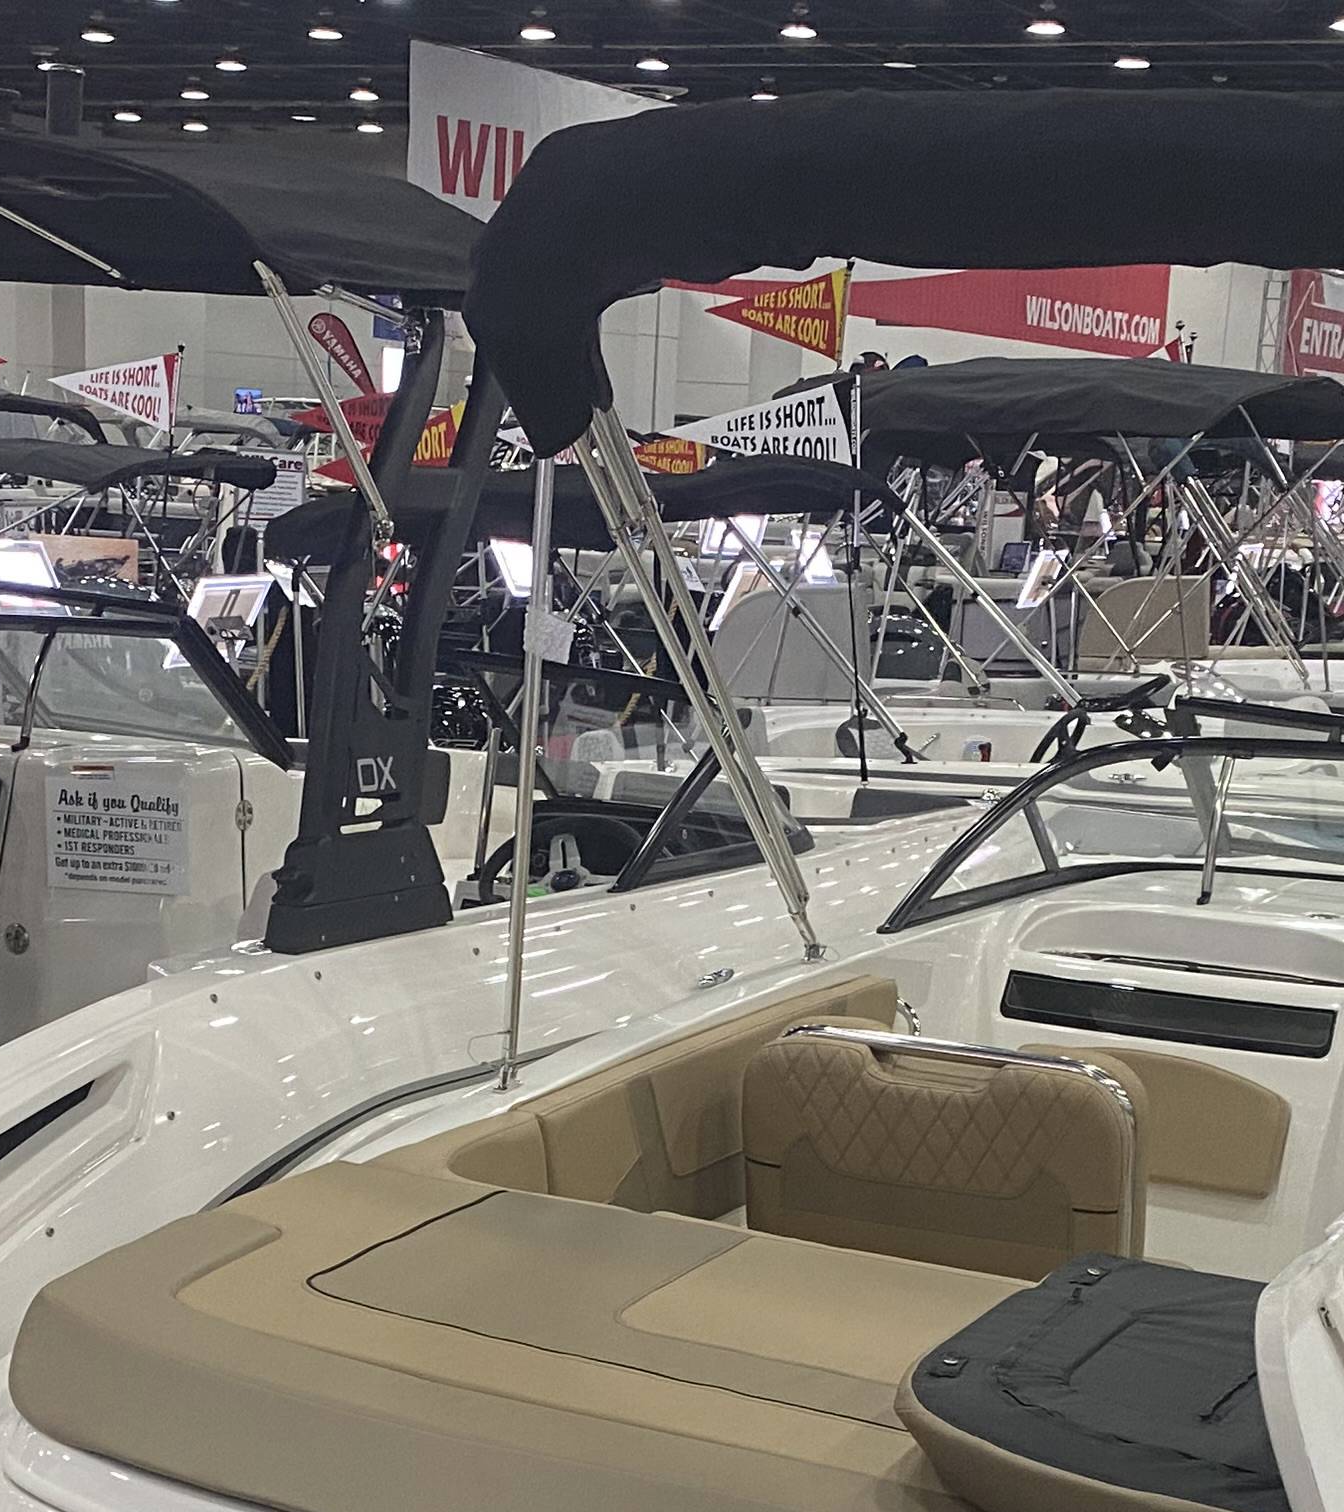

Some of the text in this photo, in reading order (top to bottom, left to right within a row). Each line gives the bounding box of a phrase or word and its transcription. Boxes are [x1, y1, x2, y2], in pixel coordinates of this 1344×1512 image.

[754, 290, 776, 308] LIFE
[777, 288, 787, 308] IS
[741, 308, 829, 350] BOATS ARE COOL!
[1026, 294, 1160, 345] WILSONBOATS.COM
[322, 331, 363, 379] YAMAHA
[90, 371, 110, 384] LIFE
[111, 369, 120, 385] IS
[78, 384, 162, 423] BOATS ARE COOL!
[727, 395, 837, 433] LIFE IS SHORT...
[711, 434, 756, 452] BOATS
[760, 436, 789, 455] ARE
[356, 756, 397, 793] DX
[58, 788, 180, 817] Ask if you Qualify
[63, 826, 100, 840] MEDICAL
[64, 840, 135, 856] 1ST RESPONDERS
[102, 860, 123, 871] extra
